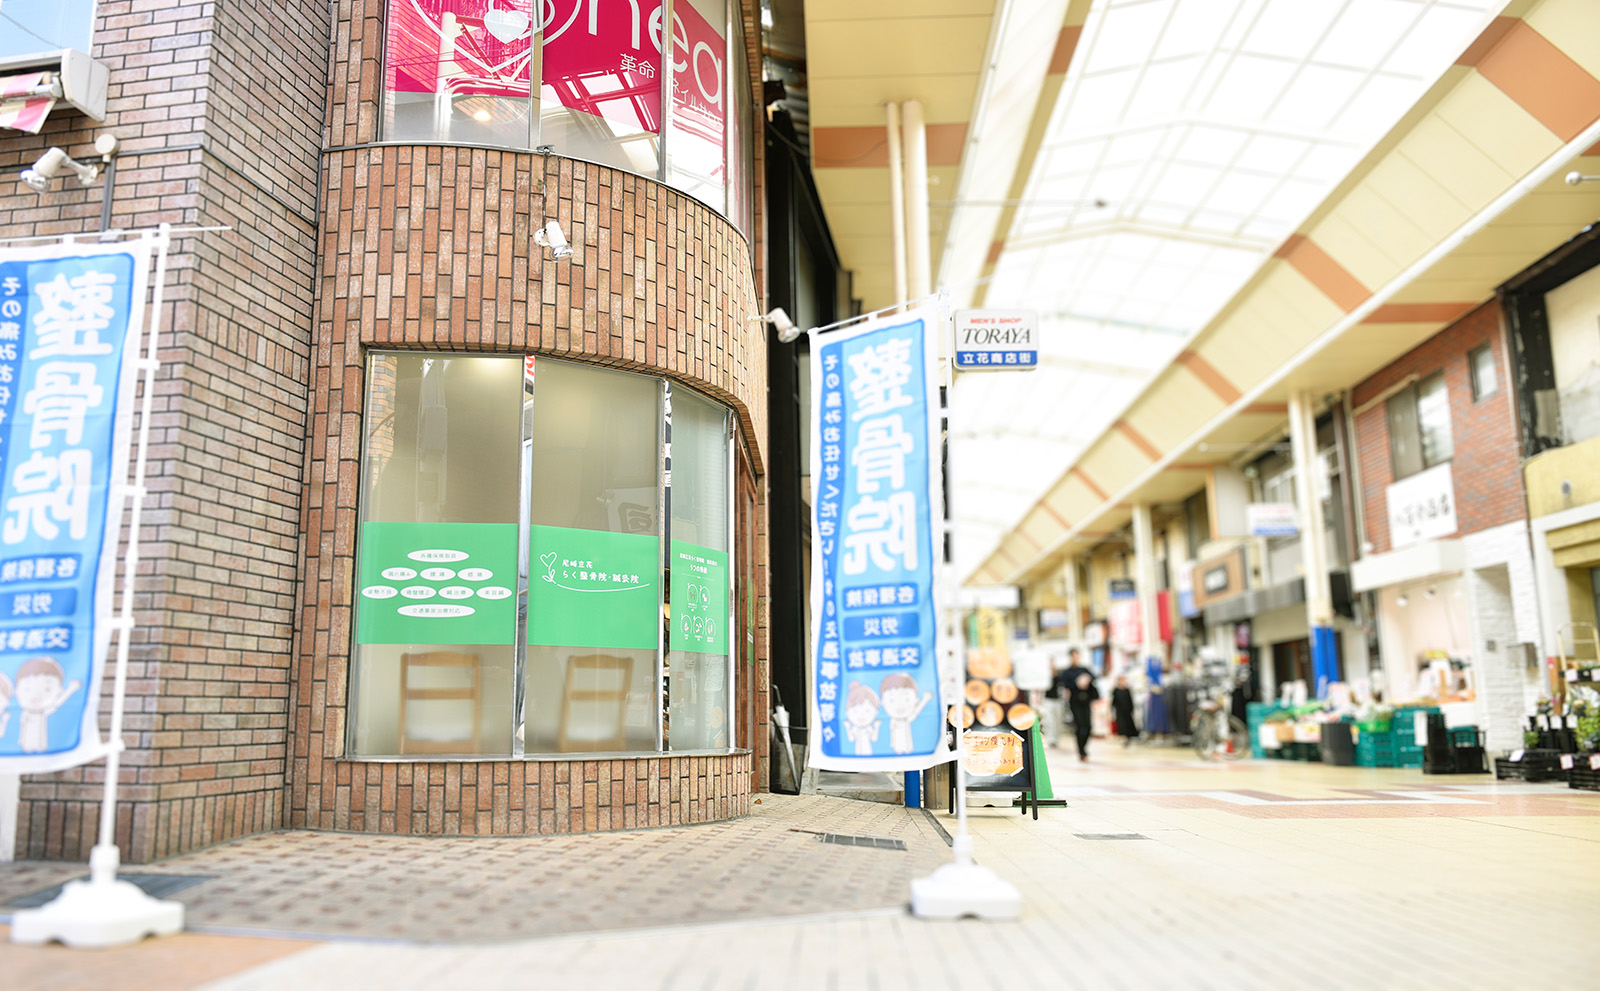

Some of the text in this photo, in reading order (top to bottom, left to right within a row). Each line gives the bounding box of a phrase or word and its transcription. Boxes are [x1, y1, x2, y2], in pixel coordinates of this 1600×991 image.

[620, 53, 656, 79] 革命
[962, 327, 1031, 345] TORAYA
[962, 352, 1032, 364] 立花商店街
[562, 559, 593, 569] 尼崎立花
